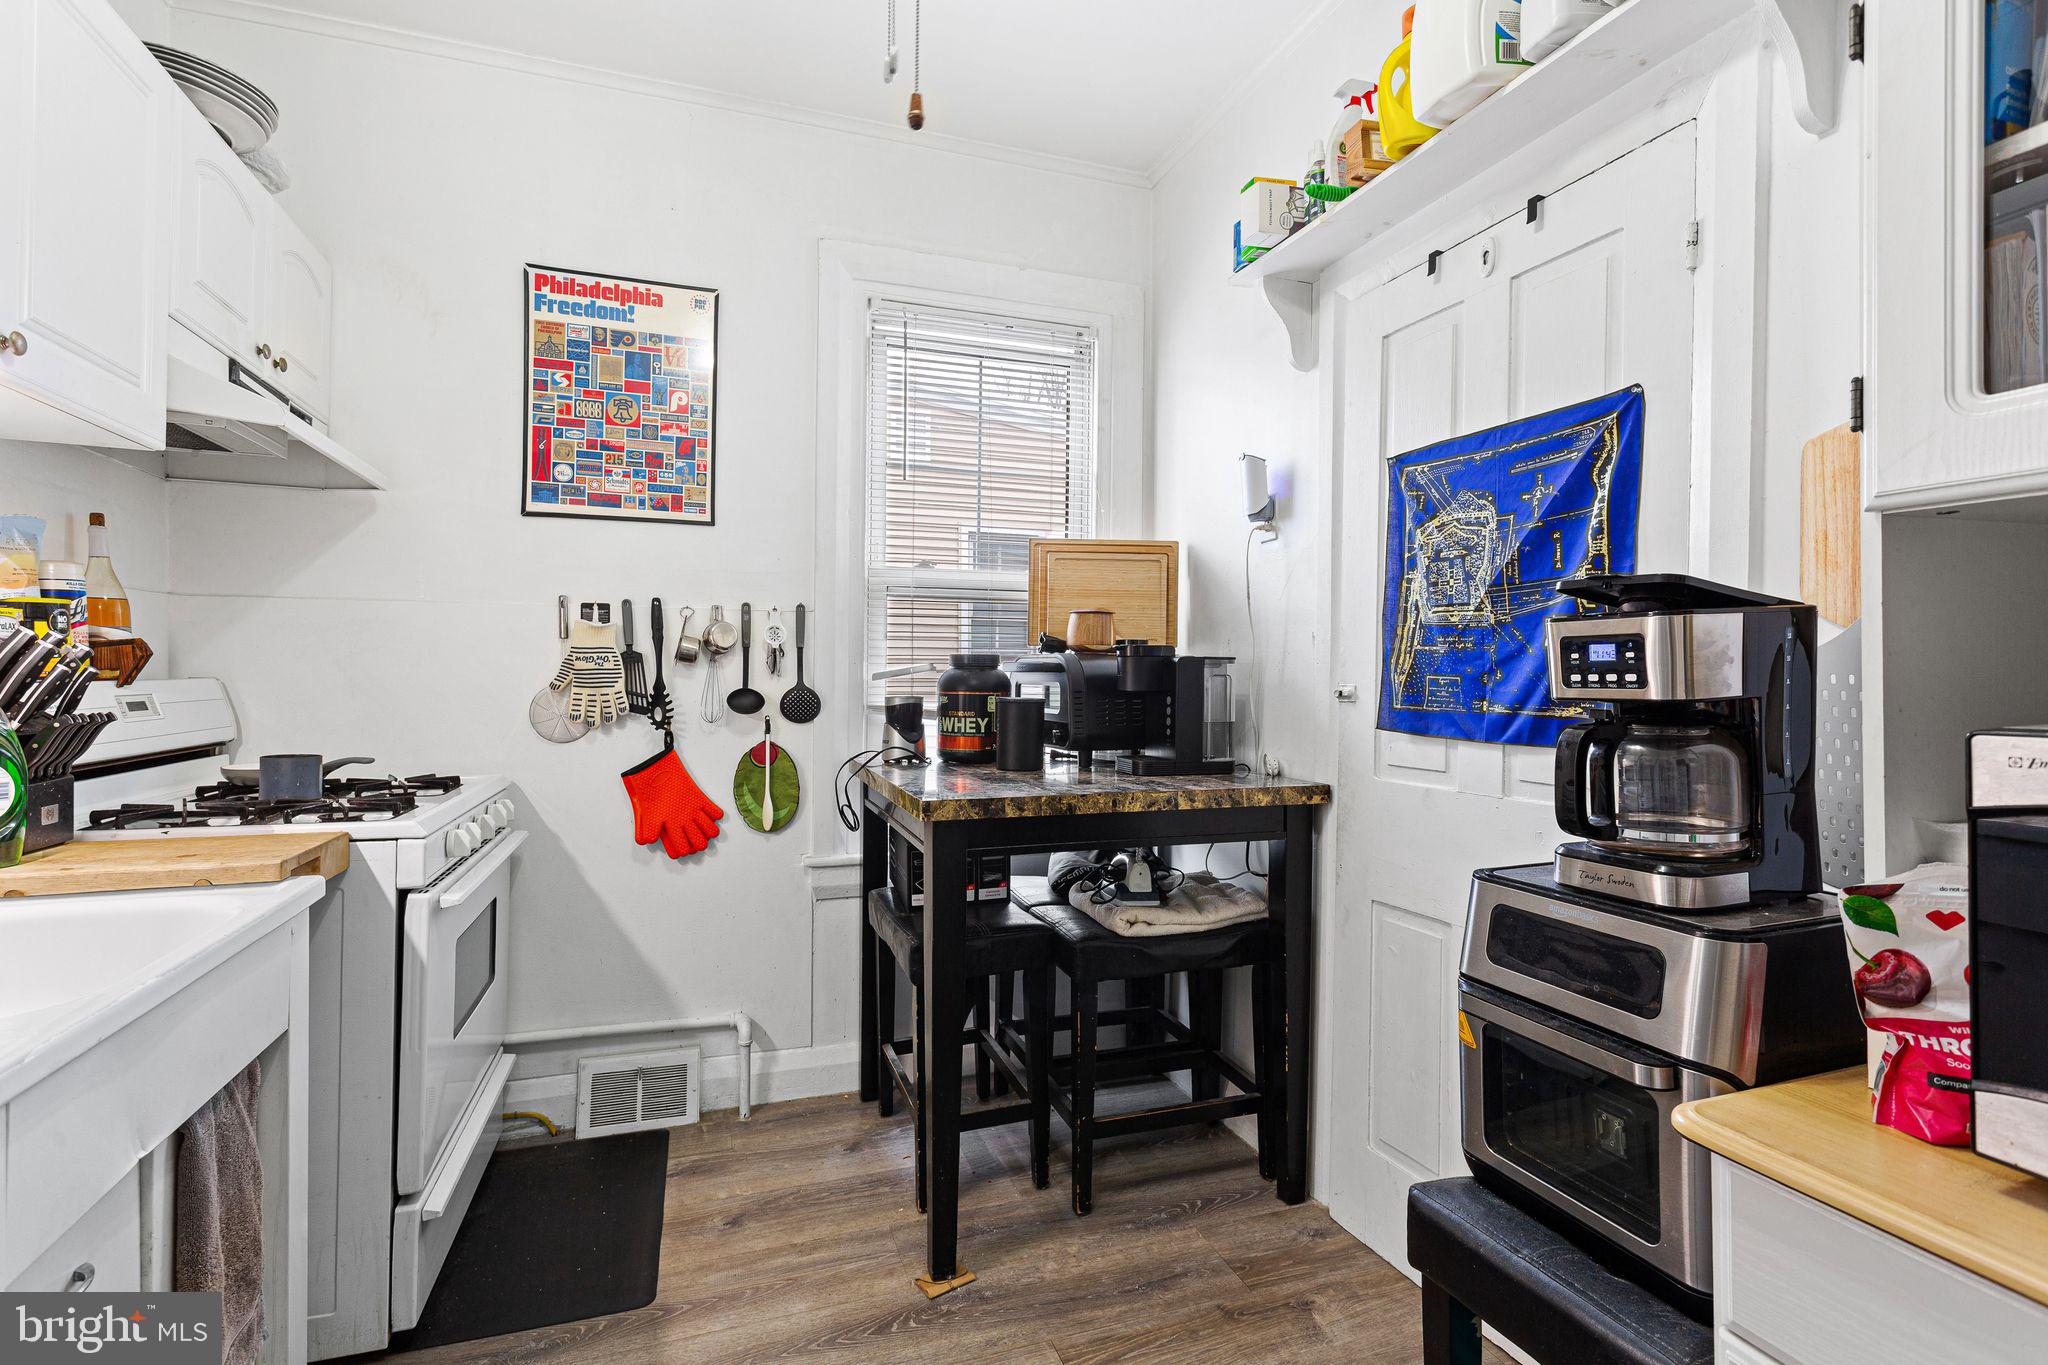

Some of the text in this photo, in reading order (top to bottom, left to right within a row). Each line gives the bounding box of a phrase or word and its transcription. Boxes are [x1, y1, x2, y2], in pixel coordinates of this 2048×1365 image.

[534, 273, 664, 307] Philadelphia
[534, 293, 635, 323] Freedom!
[605, 453, 624, 466] 215
[57, 615, 68, 623] NO
[575, 655, 594, 663] Glove
[942, 717, 989, 733] WHEY
[1578, 869, 1604, 884] Taylor
